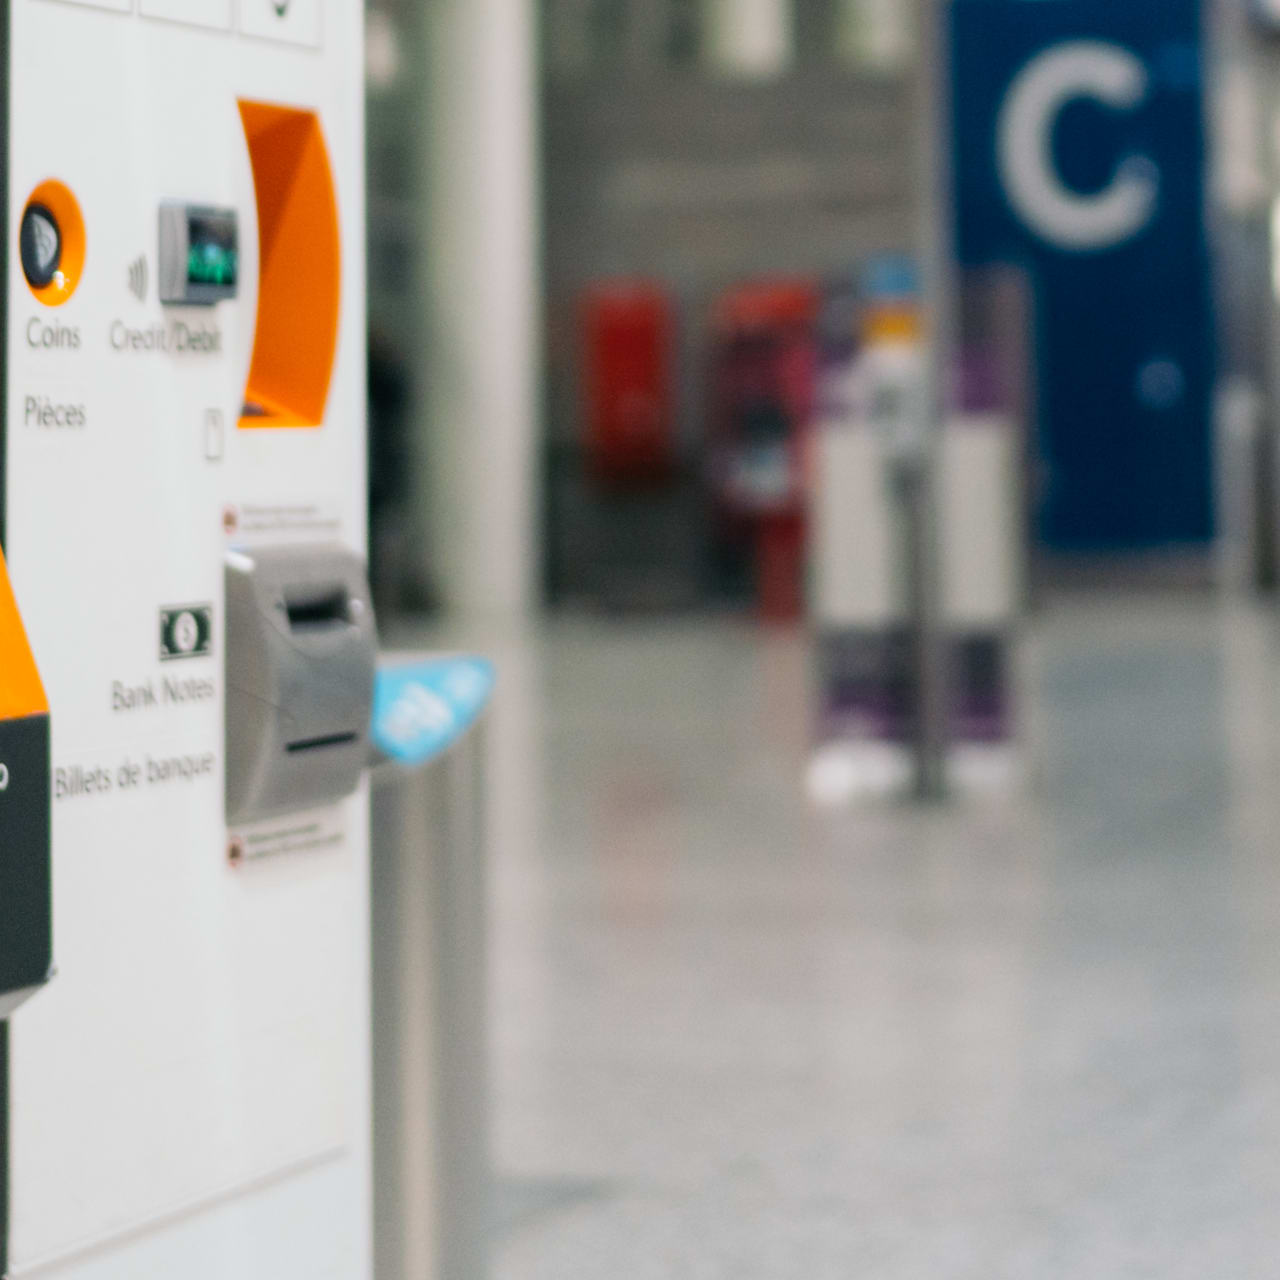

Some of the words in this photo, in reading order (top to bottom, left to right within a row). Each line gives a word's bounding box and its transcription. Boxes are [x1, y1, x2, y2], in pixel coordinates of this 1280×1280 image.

[998, 37, 1161, 251] C
[26, 316, 80, 349] Coins
[24, 395, 86, 428] Pièces
[112, 677, 157, 712] Bank
[162, 673, 214, 703] Notes
[55, 764, 111, 799] Billets
[118, 756, 140, 788] de
[145, 752, 215, 783] banque
